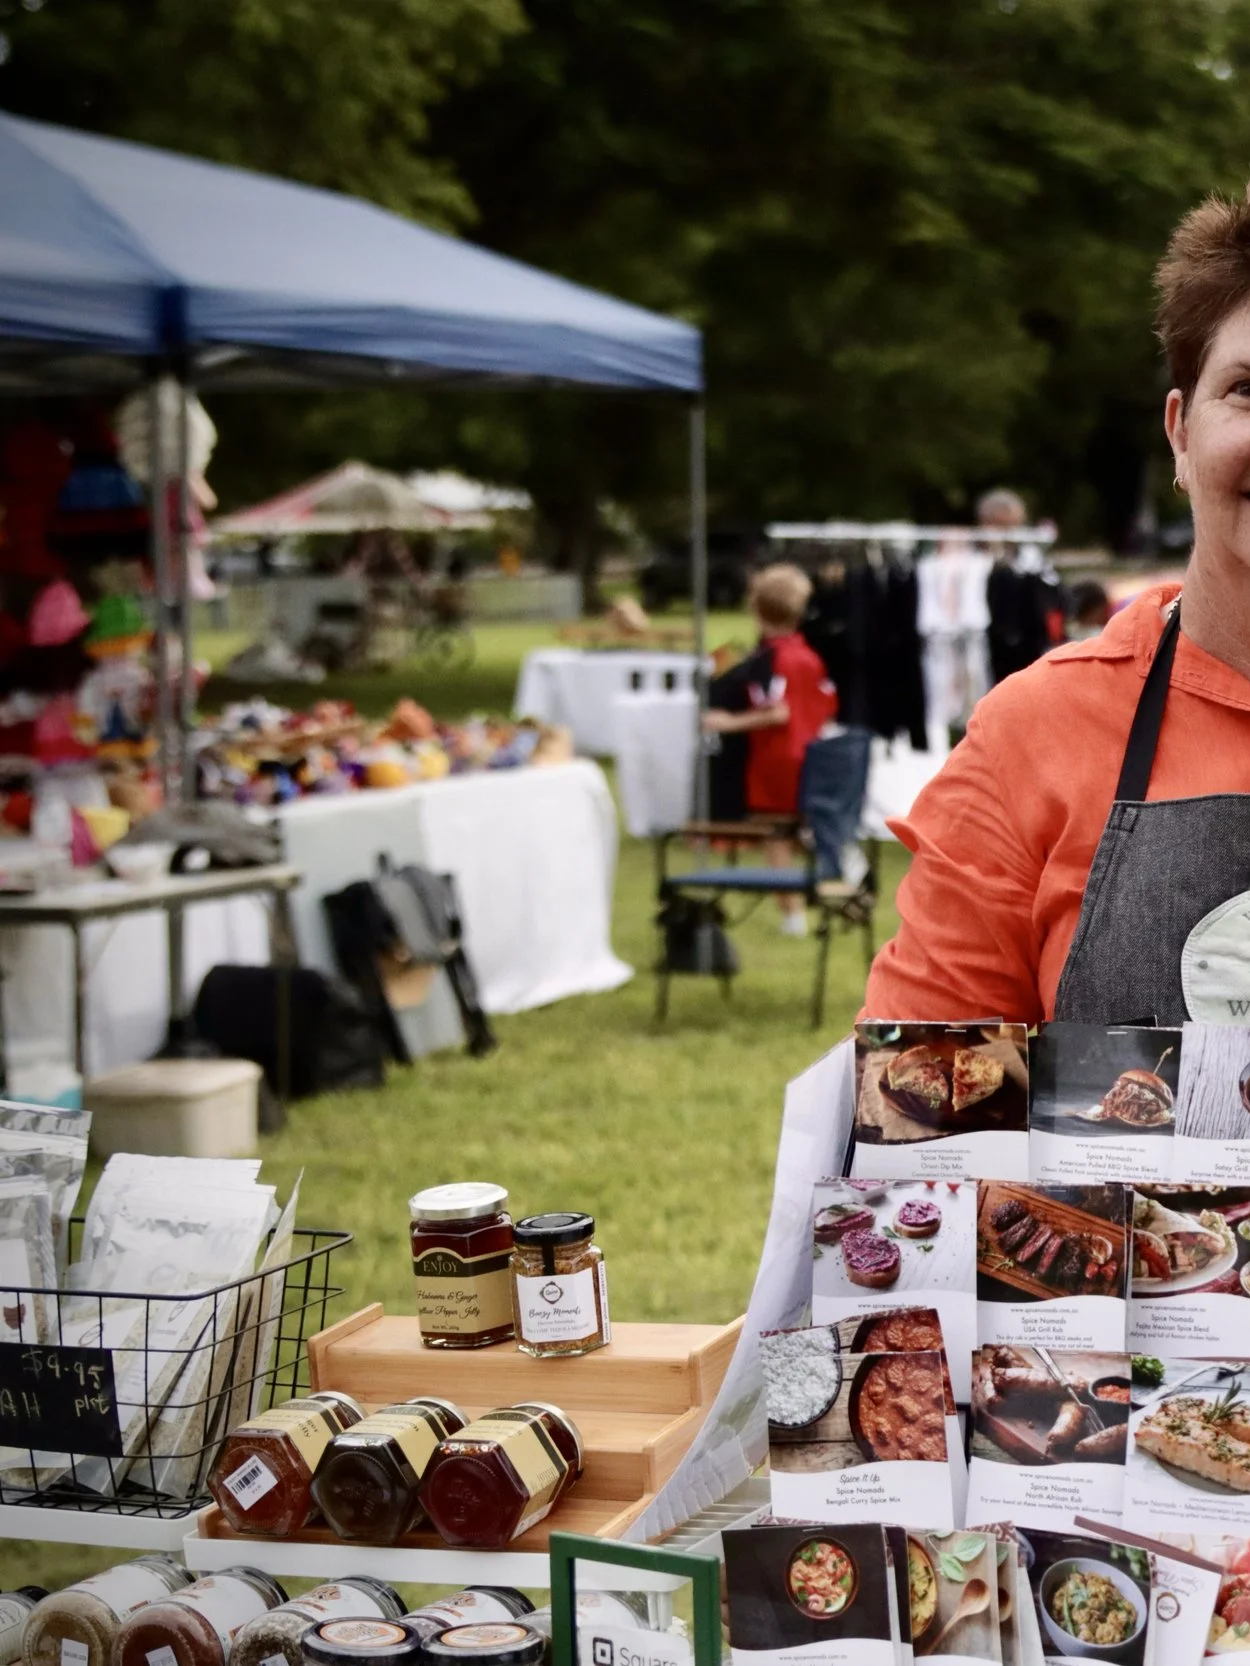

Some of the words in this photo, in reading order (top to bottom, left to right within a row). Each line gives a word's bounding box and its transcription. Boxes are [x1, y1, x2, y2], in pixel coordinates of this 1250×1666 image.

[921, 1154, 937, 1162] Spice
[1086, 1152, 1103, 1161] Spice
[1105, 1154, 1133, 1163] Nomads
[940, 1163, 950, 1171] Dip
[1059, 1160, 1087, 1168] American
[1122, 1164, 1139, 1172] Spice
[1140, 1166, 1159, 1174] Blend
[1214, 1163, 1232, 1173] Satay
[422, 1259, 458, 1275] ENJOY
[529, 1308, 551, 1319] Boozy
[1151, 1313, 1167, 1322] Spice
[1168, 1314, 1195, 1323] Nomads
[1021, 1317, 1038, 1325] Spice
[1040, 1317, 1067, 1325] Nomads
[1152, 1323, 1176, 1331] Mexican
[1177, 1323, 1192, 1332] Spice
[1193, 1325, 1210, 1333] Blend
[22, 1347, 105, 1390] $9.95
[839, 1473, 860, 1485] Spice
[870, 1473, 881, 1485] Up
[836, 1487, 854, 1496] Spice
[856, 1485, 885, 1495] Nomads
[1030, 1482, 1049, 1491] Spice
[1050, 1484, 1080, 1494] Nomads
[850, 1497, 869, 1505] Curry
[870, 1496, 887, 1505] Spice
[1025, 1491, 1044, 1499] North
[1046, 1493, 1069, 1501] African
[1070, 1495, 1083, 1503] Rub
